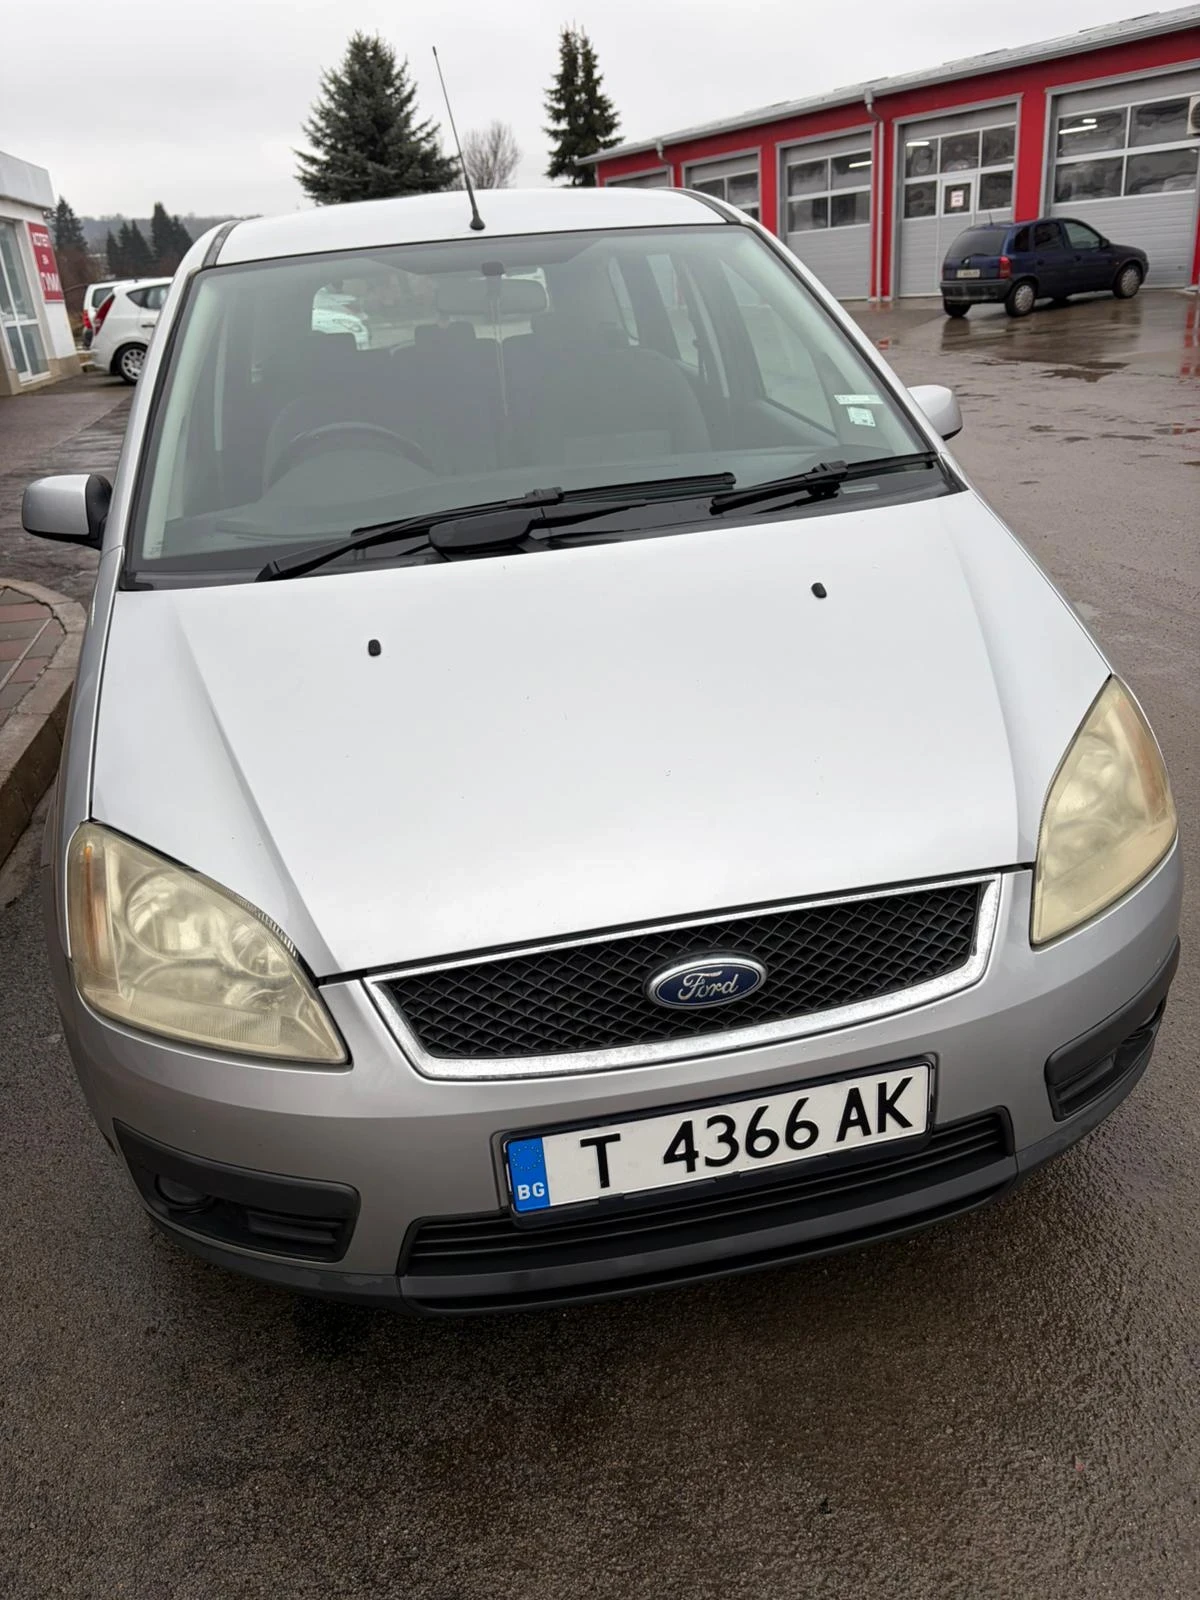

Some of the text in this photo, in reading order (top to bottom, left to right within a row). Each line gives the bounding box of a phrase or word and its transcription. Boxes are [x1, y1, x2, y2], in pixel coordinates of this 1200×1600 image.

[678, 970, 739, 1000] Ford
[580, 1076, 913, 1189] T 4366 AK
[517, 1181, 546, 1201] BG
